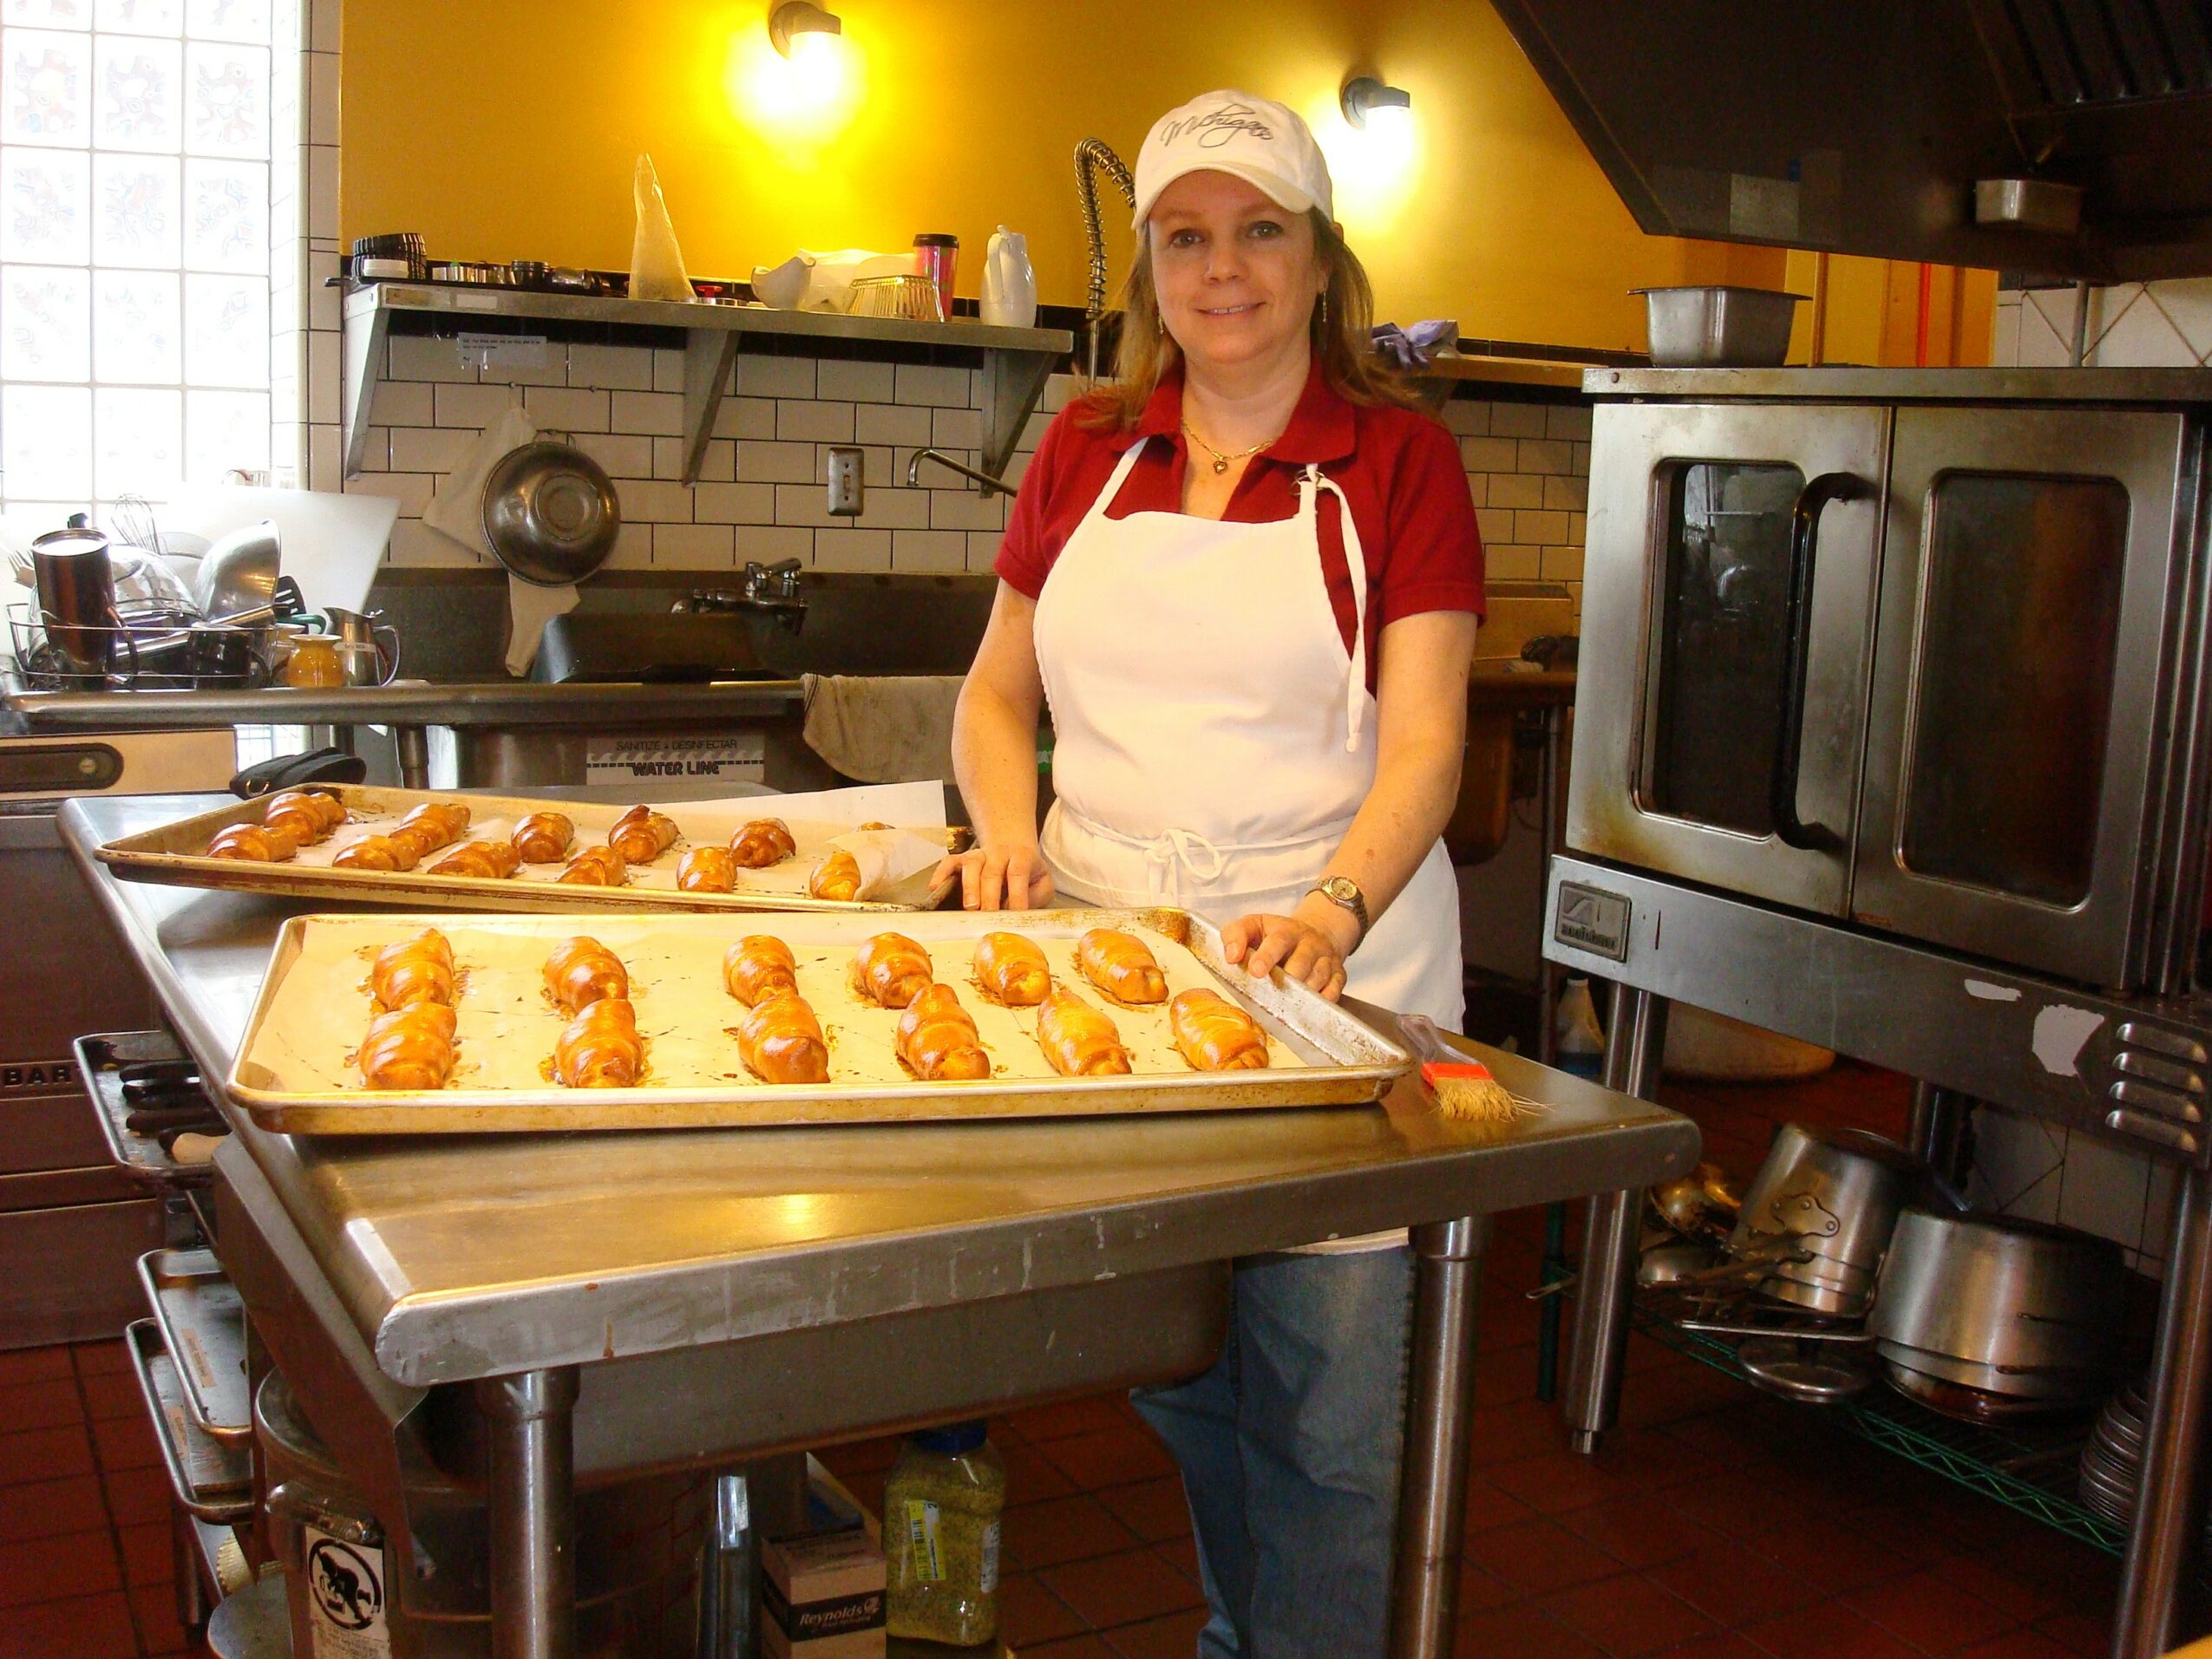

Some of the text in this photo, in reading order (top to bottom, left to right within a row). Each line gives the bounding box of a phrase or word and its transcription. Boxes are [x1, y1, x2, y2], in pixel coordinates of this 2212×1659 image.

[616, 739, 737, 751] SANITIZE DESINFECTAR
[632, 761, 720, 776] WATER LINE
[799, 1603, 863, 1627] Reynolds
